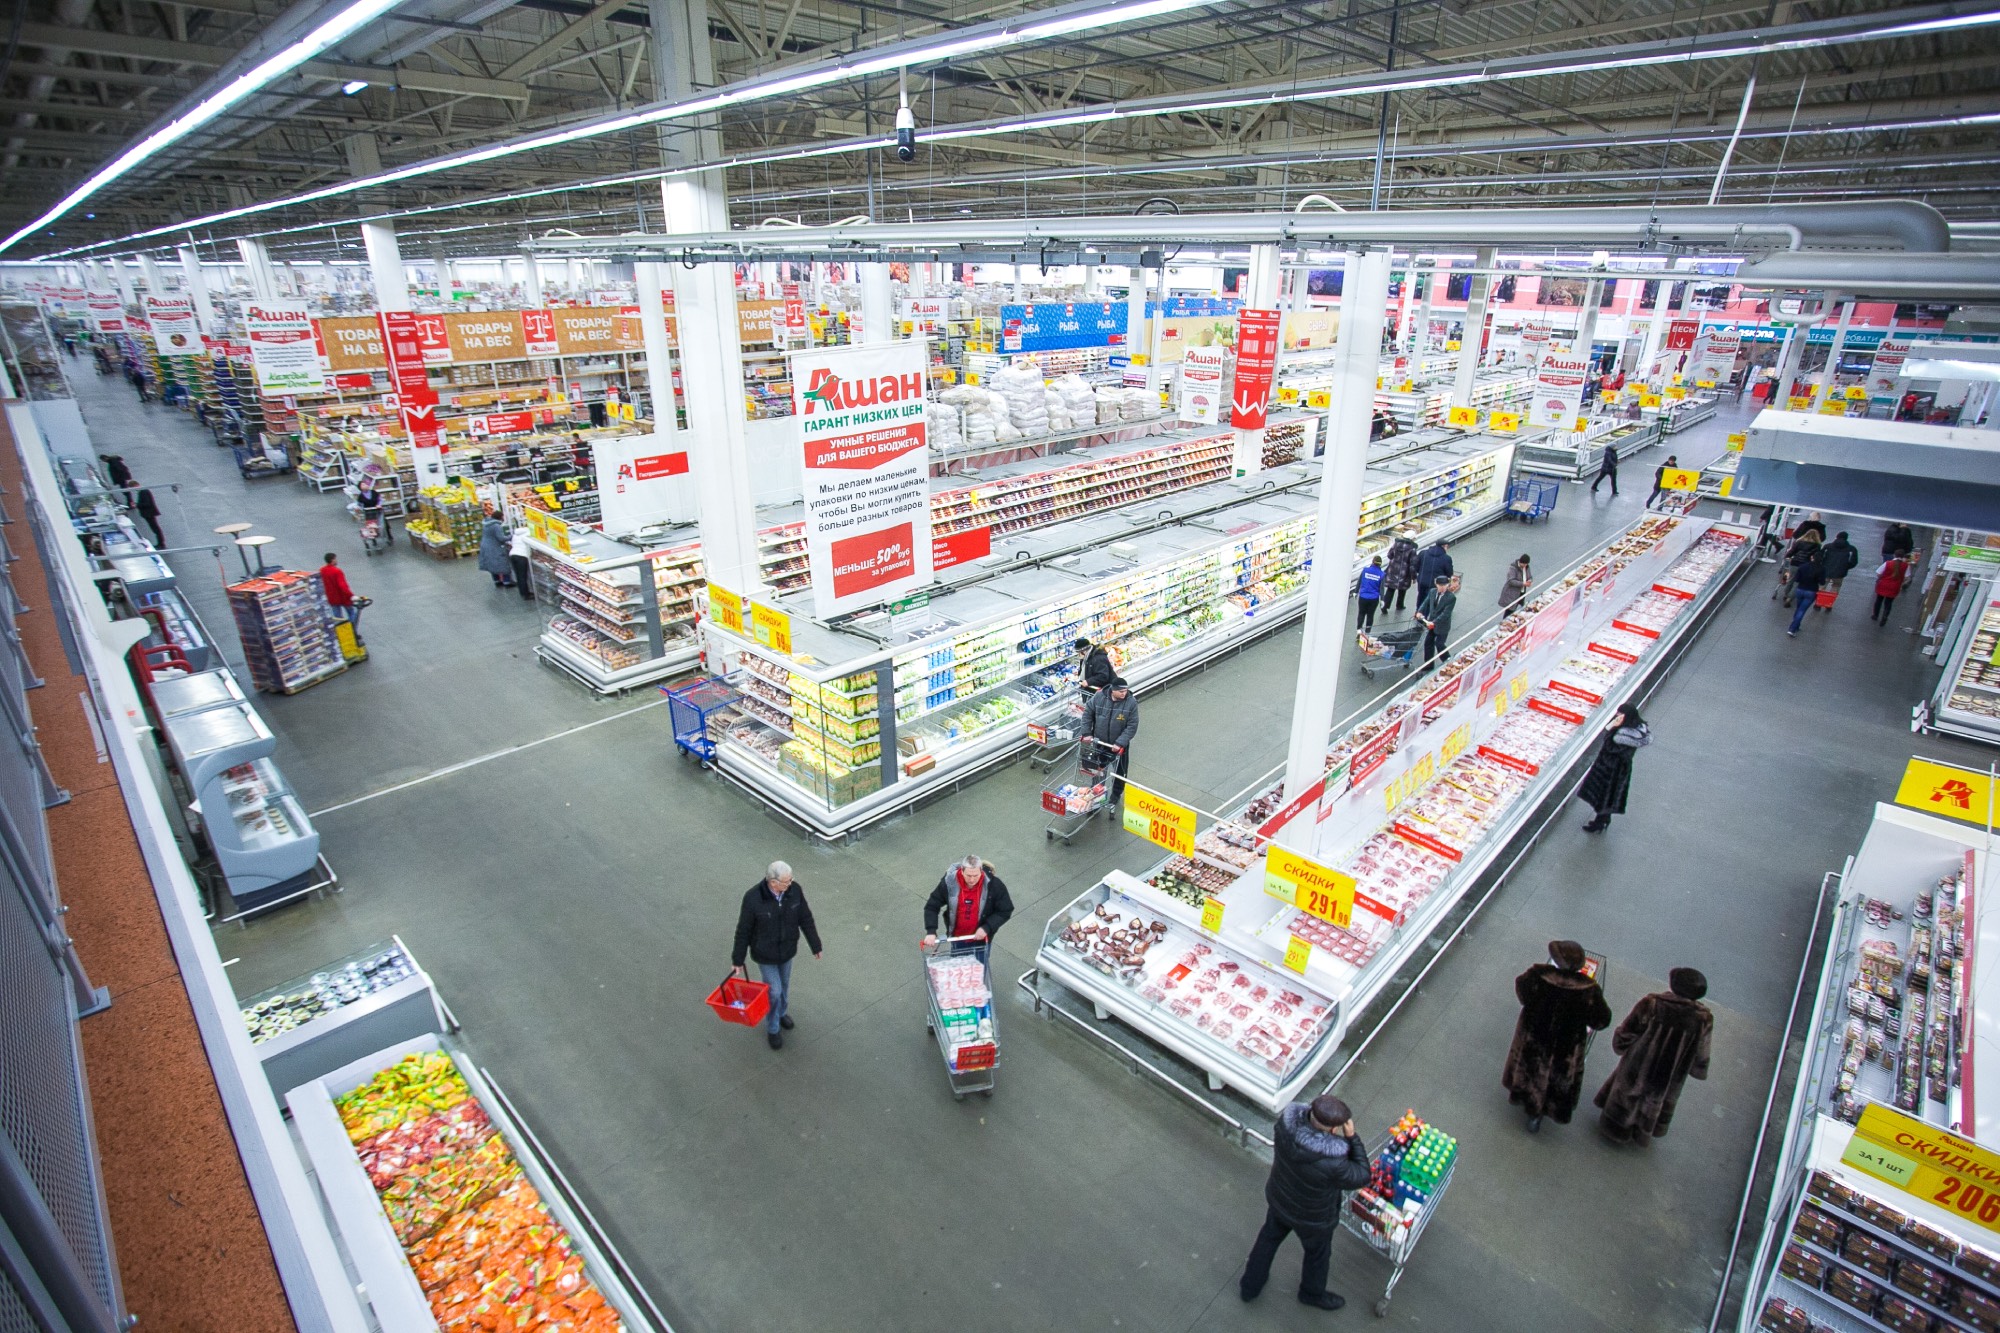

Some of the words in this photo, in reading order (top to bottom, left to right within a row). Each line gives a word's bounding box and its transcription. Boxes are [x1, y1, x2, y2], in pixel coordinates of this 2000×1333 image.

[147, 297, 189, 307] Ашан
[911, 302, 940, 313] Ашан
[247, 307, 307, 322] Ашан
[458, 322, 513, 335] ТОВАРЫ
[564, 318, 613, 329] ТОВАРЫ
[744, 321, 762, 331] НА
[1059, 322, 1080, 331] РЫБА
[1097, 320, 1116, 329] РЫБА
[1525, 323, 1552, 332] Ашан
[464, 337, 484, 349] НА
[487, 336, 512, 347] ВЕС
[570, 332, 585, 341] НА
[588, 330, 612, 340] ВЕС
[1710, 333, 1739, 343] Ашан
[344, 344, 368, 355] НА
[1879, 342, 1910, 352] Аша
[1185, 351, 1221, 365] Ашан
[1542, 356, 1586, 371] Ашан
[803, 368, 922, 415] Ашан
[805, 416, 850, 433] ГАРАНТ
[853, 408, 899, 425] НИЗКИХ
[902, 404, 923, 418] ЦЕН
[830, 432, 865, 449] УМНЫЕ
[866, 428, 907, 443] РЕШЕНИЯ
[817, 452, 837, 466] ДЛЯ
[840, 446, 877, 460] ВАШЕГО
[878, 437, 919, 453] БЮДЖЕТА
[820, 485, 836, 494] Мы
[838, 478, 872, 492] делаем
[875, 467, 917, 483] маленькие
[810, 494, 853, 511] упаковки
[869, 484, 899, 496] низким
[900, 477, 928, 490] ценам,
[818, 507, 848, 519] чтобы
[850, 503, 865, 513] Вы
[868, 497, 893, 509] могли
[895, 491, 921, 503] купить
[819, 518, 855, 532] больше
[857, 510, 889, 525] разных
[891, 501, 923, 515] товаров
[934, 550, 951, 559] Масло
[934, 557, 957, 567] Майонез
[834, 558, 876, 577] МЕНЬШЕ
[898, 548, 910, 560] руб
[872, 568, 880, 577] за
[880, 559, 910, 575] упаковку
[715, 593, 735, 608] СКИДКИ
[759, 613, 782, 628] СКИДКИ
[1139, 800, 1180, 824] СКИДКИ
[1152, 820, 1176, 848] 399
[1284, 863, 1335, 891] СКИДКИ
[1308, 891, 1338, 920] 291
[1288, 950, 1299, 963] 291
[1939, 1135, 1974, 1154] Ашан
[1895, 1132, 2000, 1185] СКИДКИ
[1934, 1177, 2000, 1223] 206
